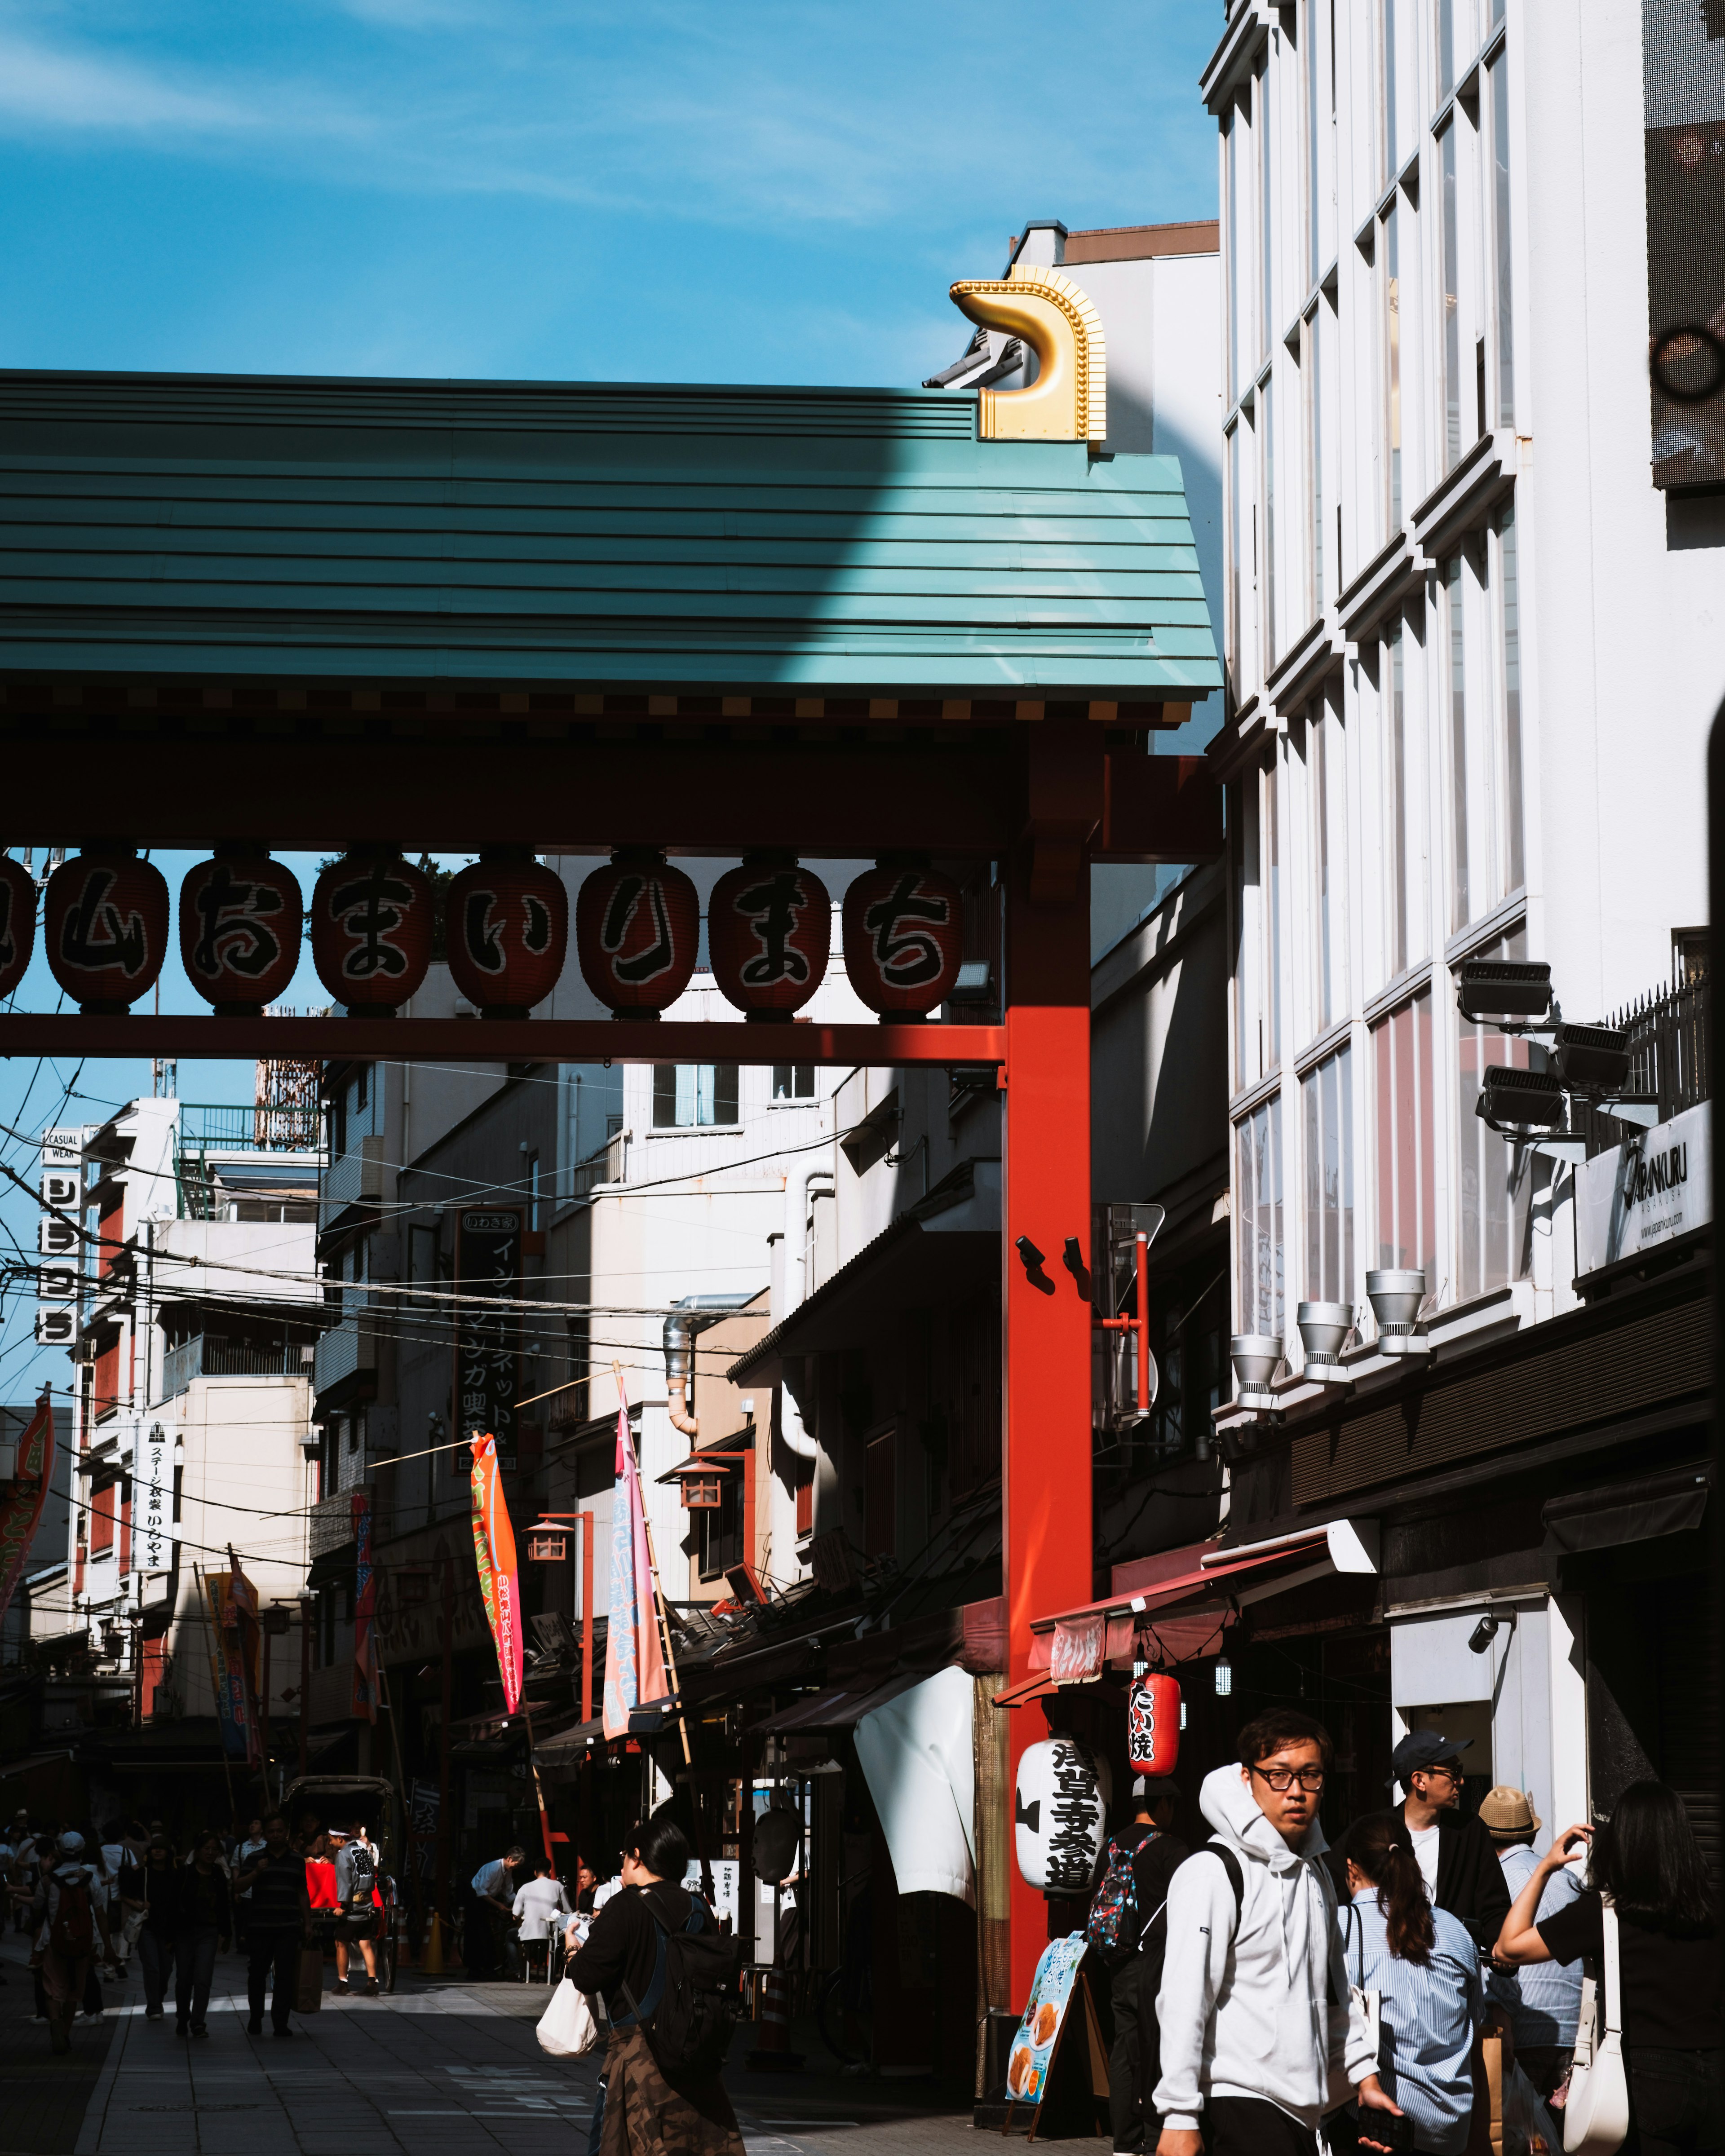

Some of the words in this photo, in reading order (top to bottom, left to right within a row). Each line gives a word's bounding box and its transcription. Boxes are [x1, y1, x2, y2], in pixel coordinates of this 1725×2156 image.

[49, 1135, 77, 1145] CASUAL
[52, 1148, 74, 1158] WEAR
[1623, 1142, 1687, 1211] JAPANKURU
[1641, 1188, 1681, 1215] ASAKUSA
[467, 1217, 513, 1229] いわき家
[1641, 1212, 1683, 1239] www.japankuru.com
[1129, 1681, 1155, 1762] たい焼
[1044, 1743, 1100, 1889] 浅草寺参道
